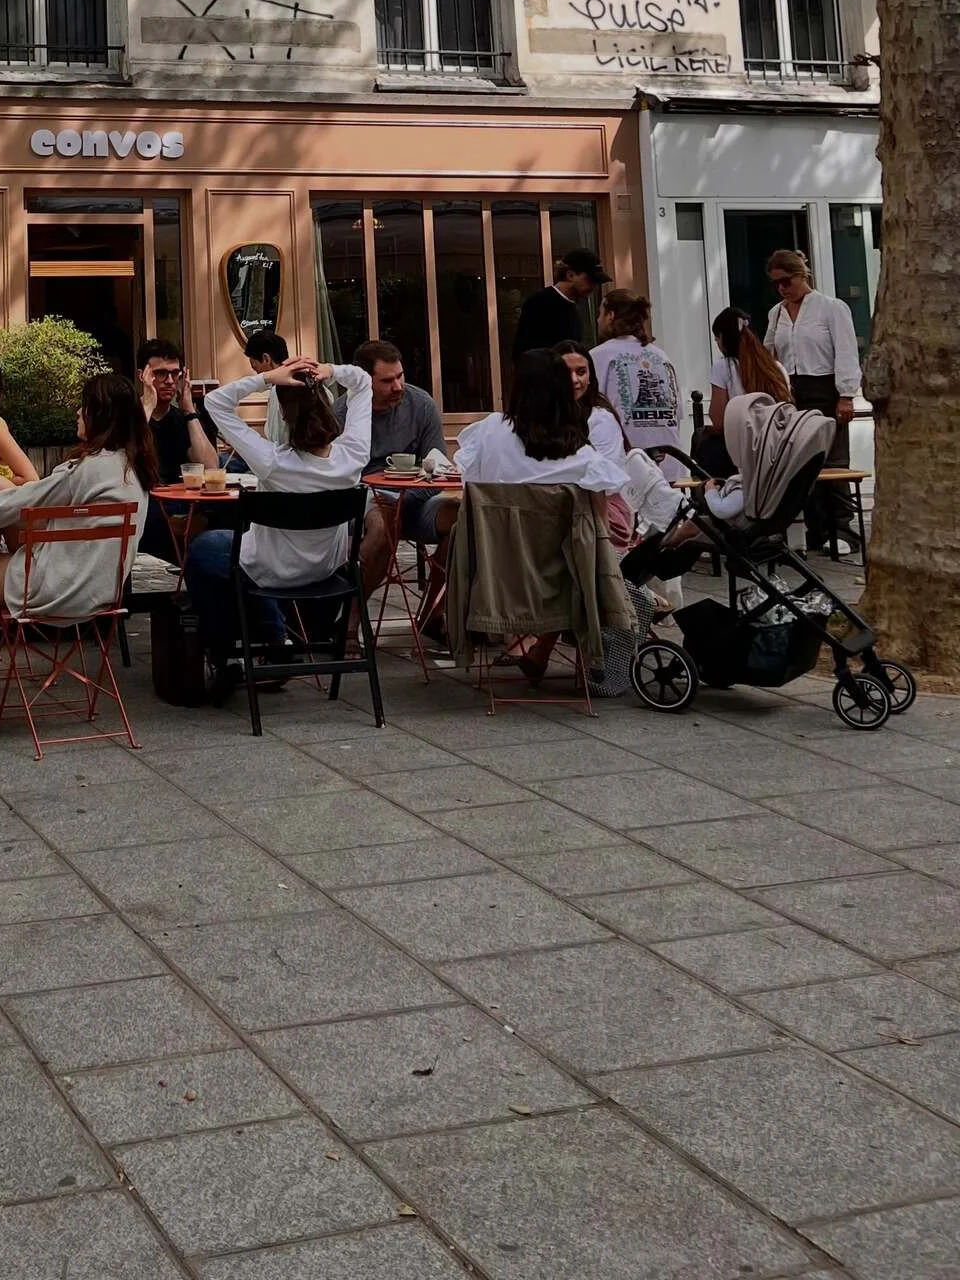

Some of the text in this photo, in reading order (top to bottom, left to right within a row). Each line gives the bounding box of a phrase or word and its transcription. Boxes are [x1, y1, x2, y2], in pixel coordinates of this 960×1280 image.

[31, 129, 184, 158] convos
[659, 207, 666, 218] 3
[632, 410, 675, 420] DEUS
